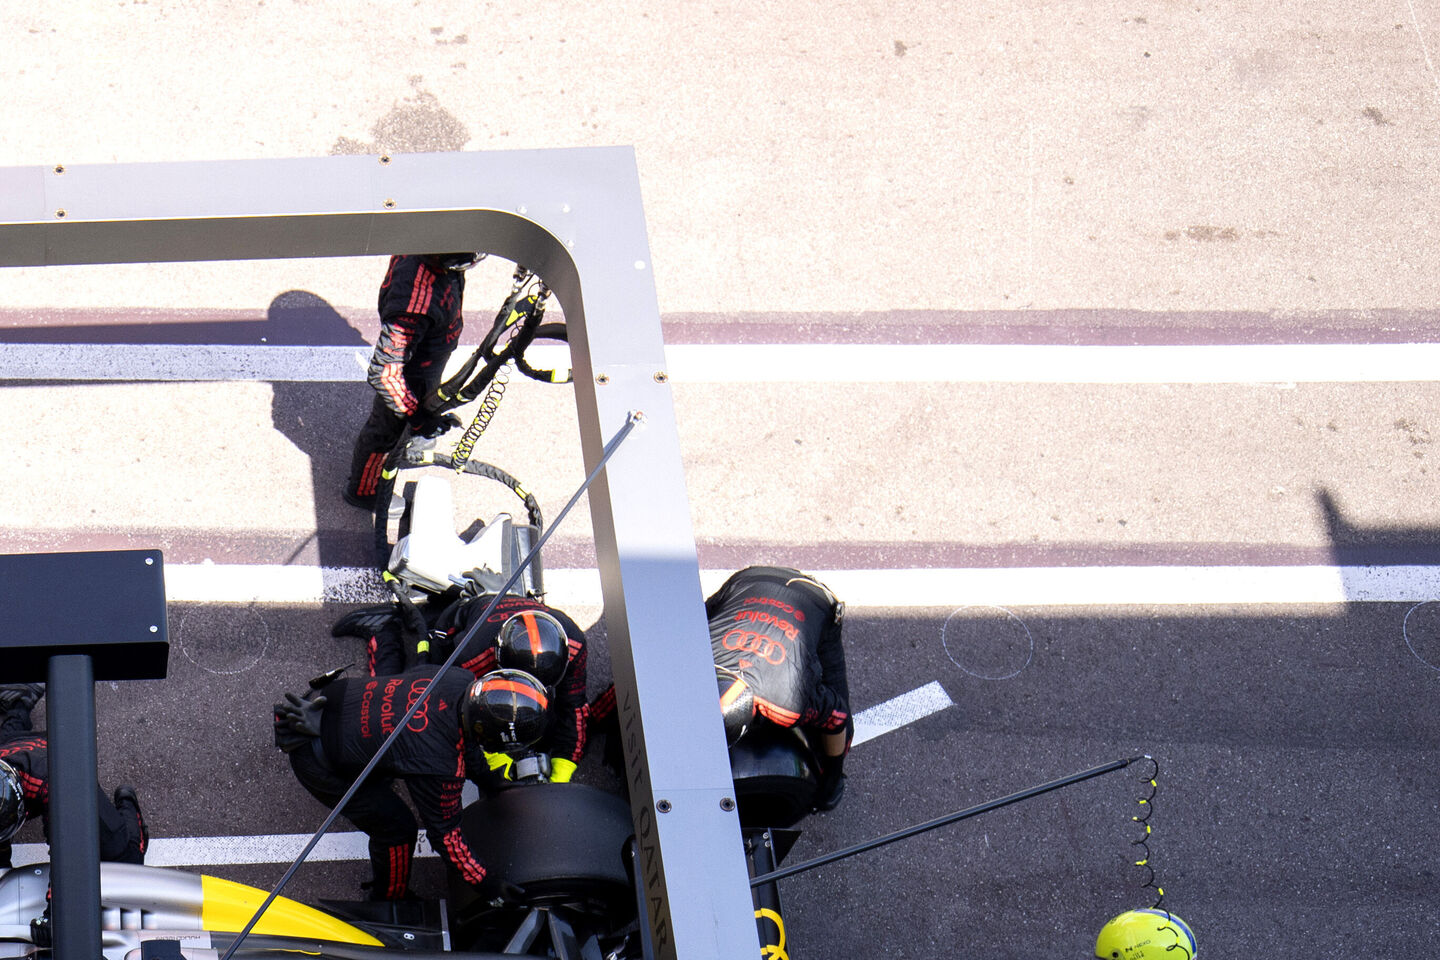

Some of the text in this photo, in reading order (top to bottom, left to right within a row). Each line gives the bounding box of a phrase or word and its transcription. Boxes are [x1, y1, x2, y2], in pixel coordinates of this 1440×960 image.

[734, 609, 800, 642] Revolut
[361, 690, 373, 740] Castrol
[380, 678, 404, 736] Revolut
